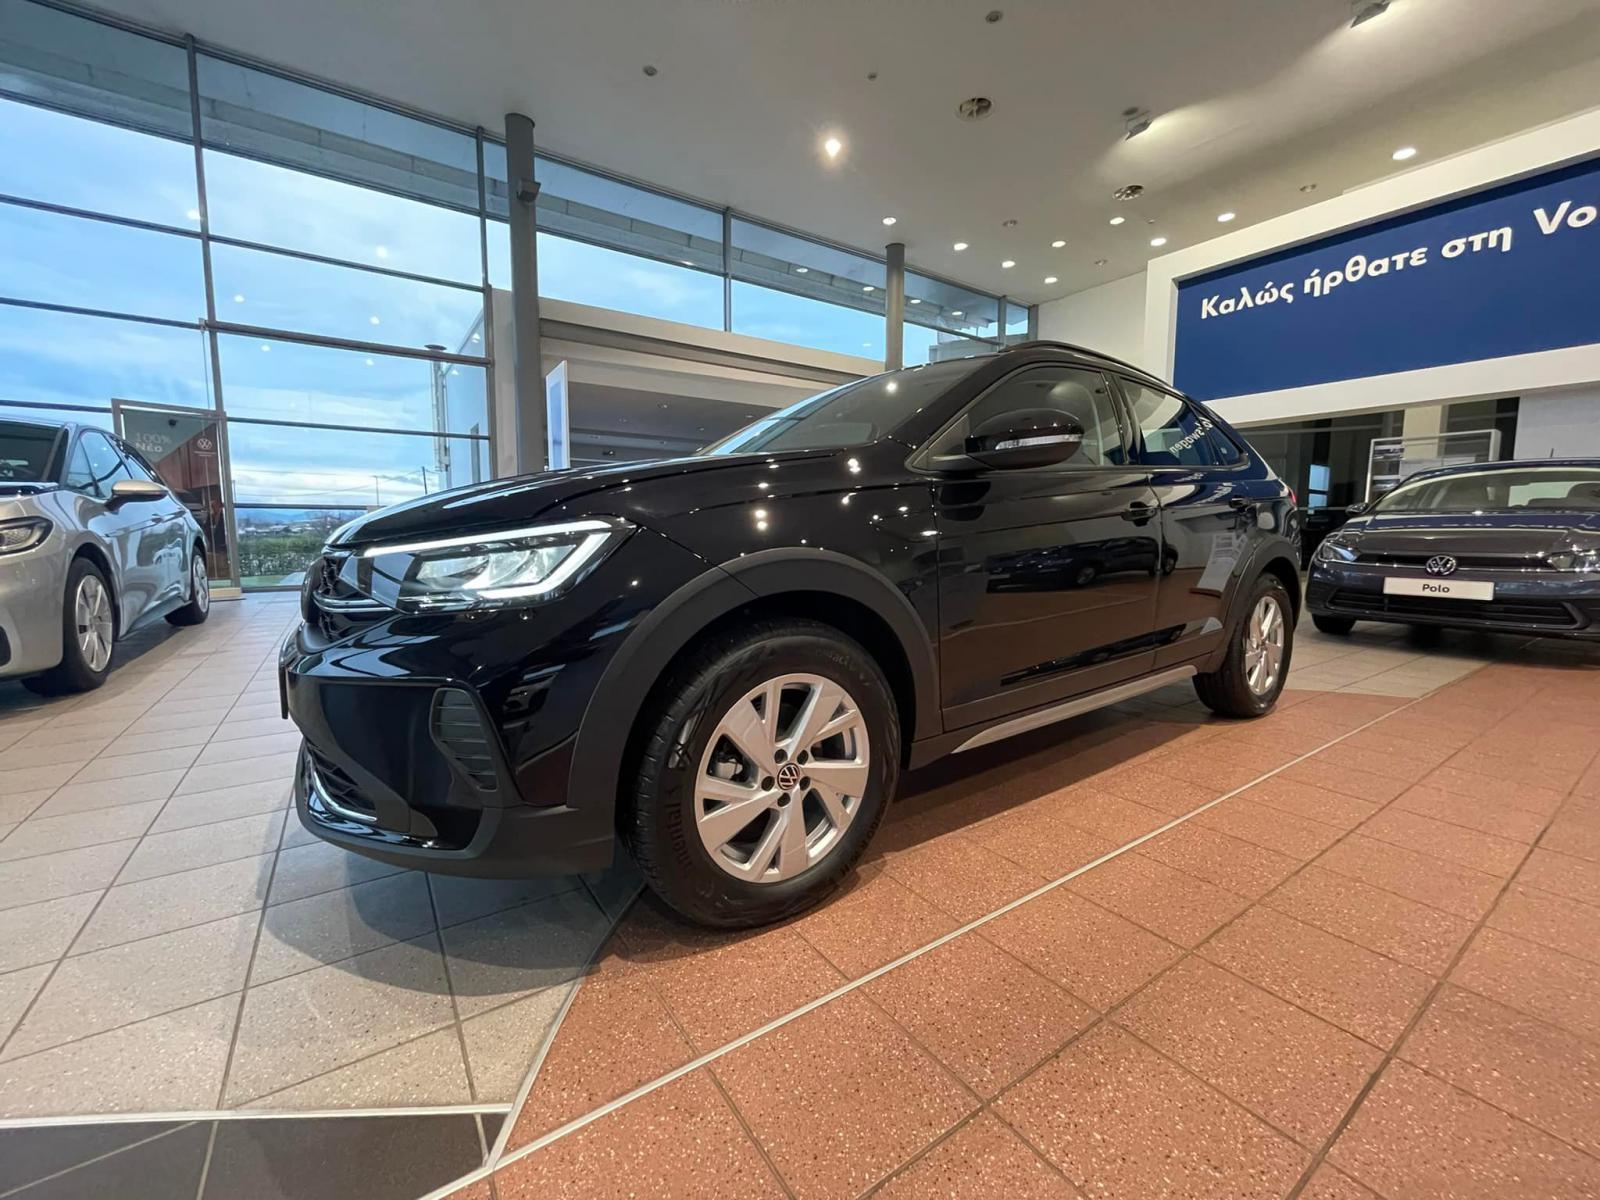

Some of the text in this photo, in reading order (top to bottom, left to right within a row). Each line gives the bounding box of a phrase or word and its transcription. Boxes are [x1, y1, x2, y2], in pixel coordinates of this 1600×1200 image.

[1200, 200, 1598, 320] Καλώς ήρθατε στη Vo
[1422, 583, 1450, 593] Polo
